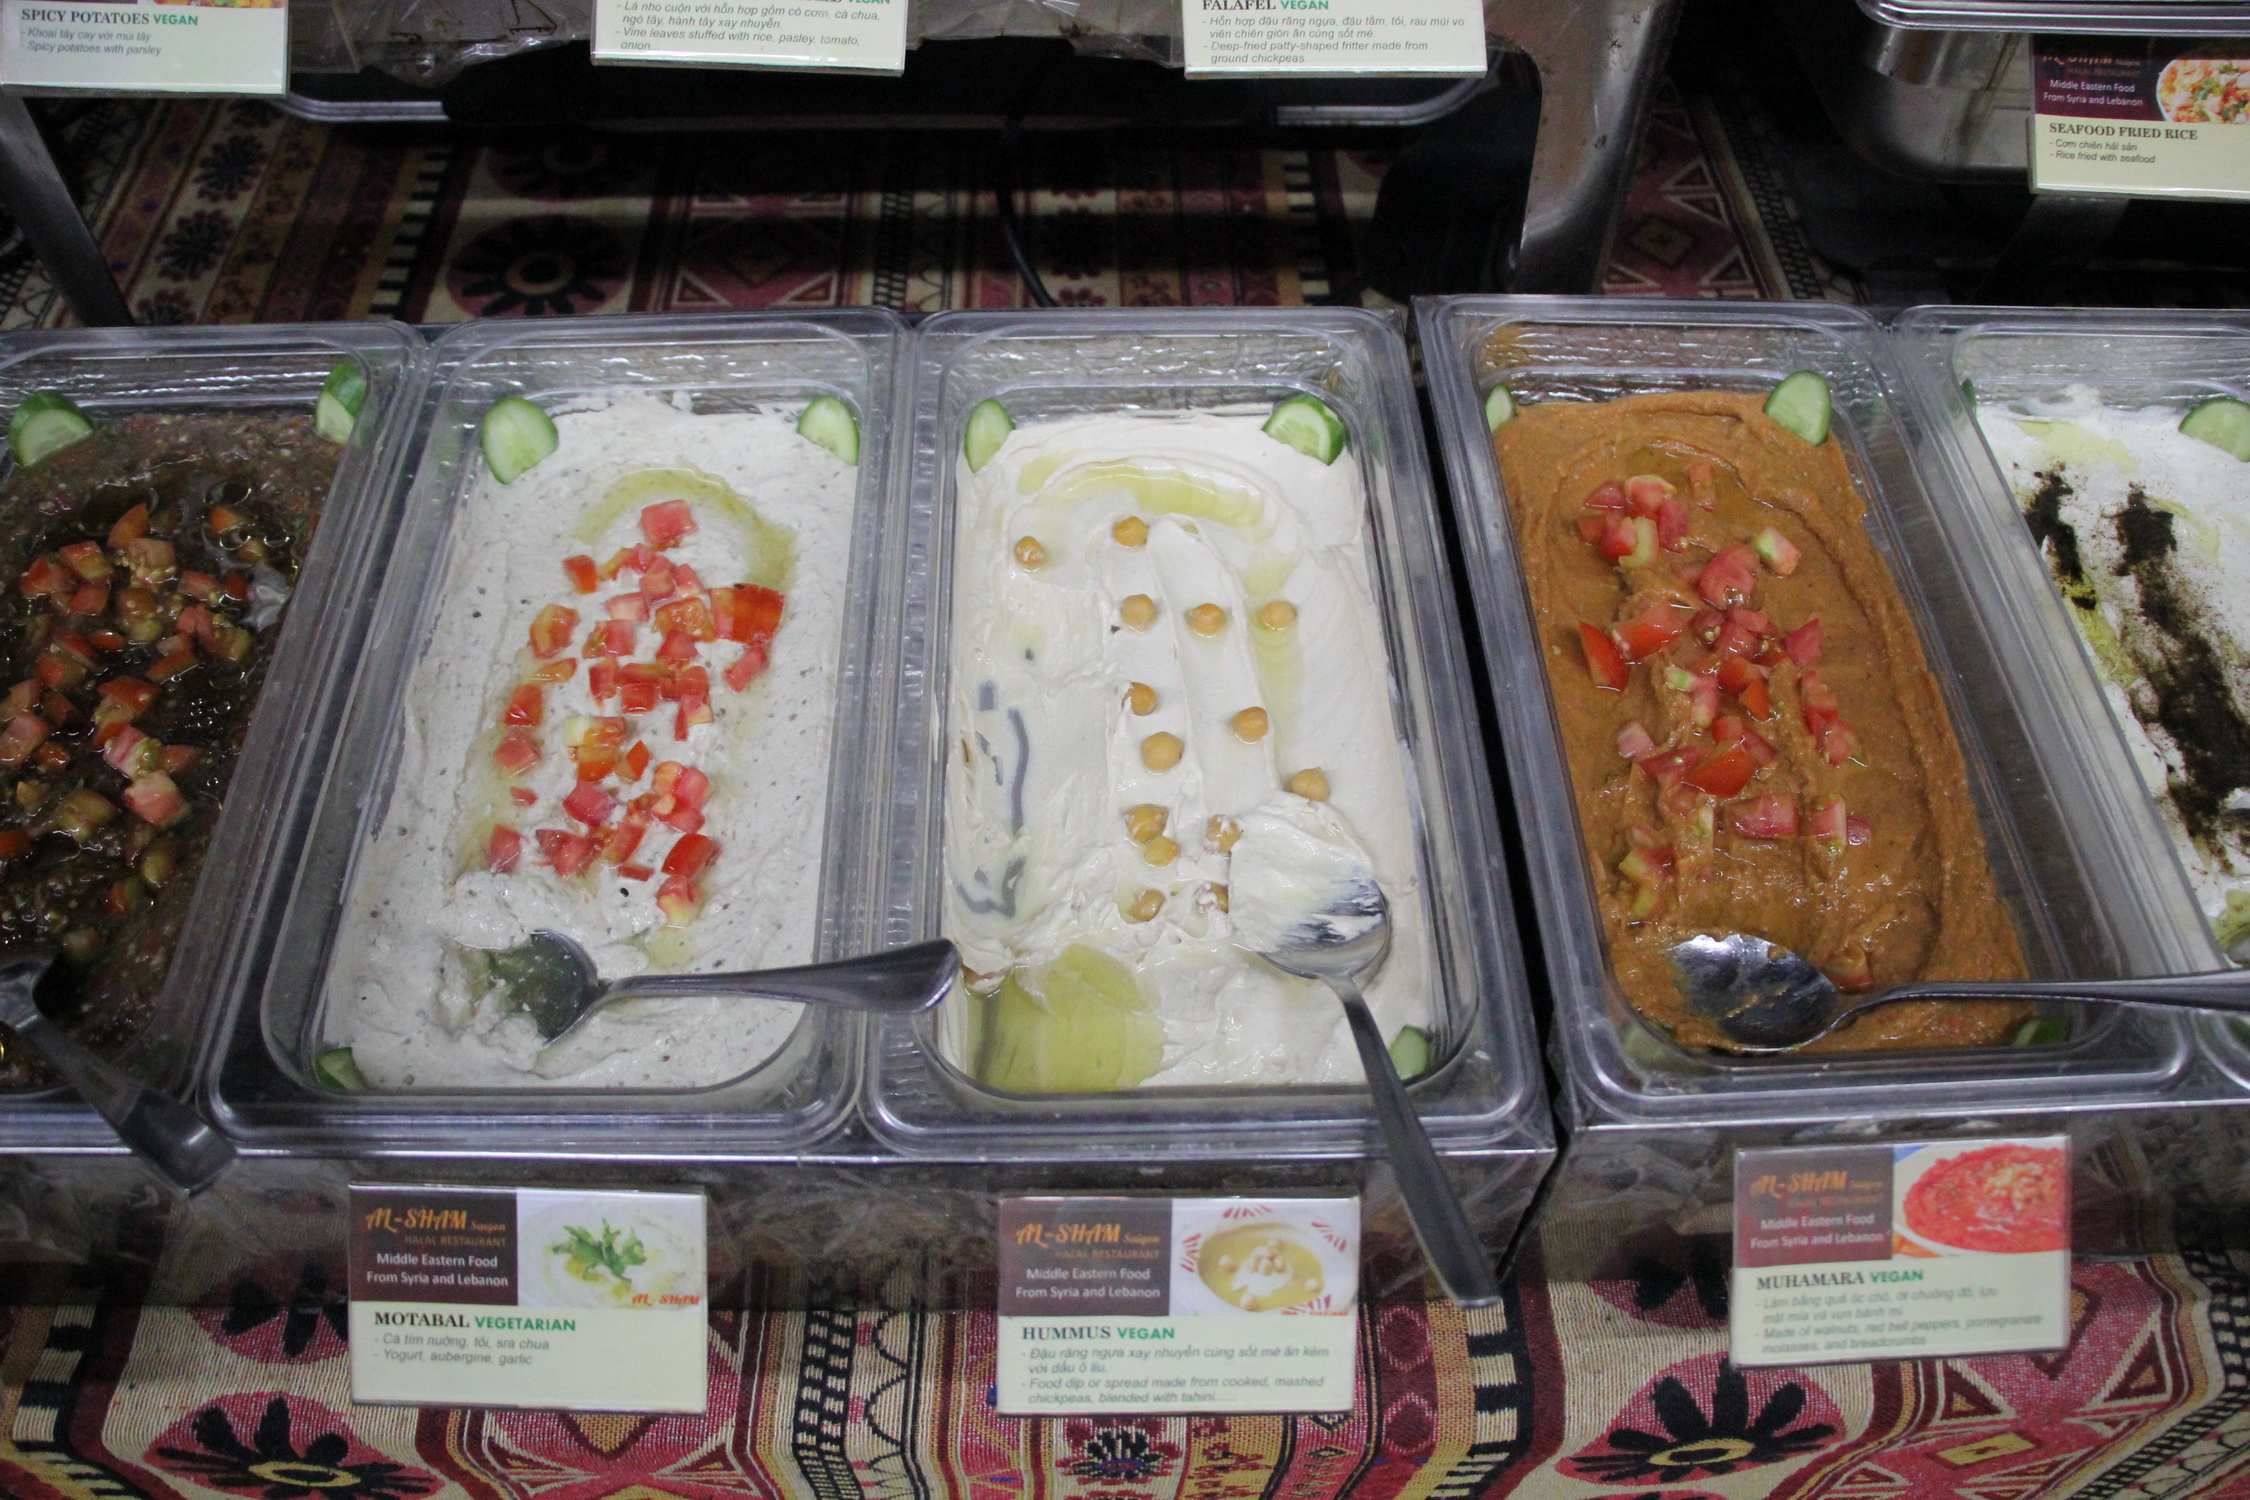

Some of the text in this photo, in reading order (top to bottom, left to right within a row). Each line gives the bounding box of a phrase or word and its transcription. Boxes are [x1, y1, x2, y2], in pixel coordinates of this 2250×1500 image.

[625, 2, 638, 11] Lá
[642, 3, 662, 11] nho
[665, 4, 691, 13] cuộn
[695, 5, 711, 13] với
[714, 3, 734, 13] hỗn
[737, 6, 757, 16] hợp
[761, 4, 785, 16] gồm
[788, 8, 802, 16] có
[835, 11, 848, 19] cà
[851, 11, 880, 21] chua,
[1203, 0, 1329, 10] FALAFEL VEGAN
[22, 9, 198, 25] SPICY POTATOES VEGAN
[669, 17, 695, 25] hành
[699, 17, 715, 28] tây
[718, 19, 737, 29] xay
[1210, 15, 1231, 26] Hỗn
[1235, 17, 1255, 27] hợp
[1259, 16, 1278, 26] đậu
[1282, 17, 1305, 27] răng
[1343, 16, 1362, 26] đậu
[1410, 18, 1426, 26] rau
[1430, 17, 1449, 26] mùi
[28, 28, 151, 42] Khoai tây cay với mùi tây
[623, 27, 646, 36] Vine
[650, 29, 685, 38] leaves
[688, 30, 725, 40] stuffed
[728, 32, 749, 40] with
[753, 32, 775, 42] rice,
[820, 36, 860, 46] tomato,
[1210, 29, 1231, 38] viên
[1235, 30, 1263, 38] chiên
[1267, 30, 1289, 39] giòn
[1293, 30, 1305, 38] ăn
[1309, 30, 1334, 39] cùng
[1338, 27, 1353, 38] sốt
[28, 42, 162, 56] Spicy potatoes with parsley
[1211, 41, 1428, 52] Deep-fried patty-shaped fritter made from
[1211, 54, 1305, 64] ground chickpeas
[2050, 80, 2135, 92] Middle Eastern Food
[2044, 93, 2143, 105] From Syria and Lebanon
[2050, 123, 2198, 139] SEAFOOD FRIED RICE
[2056, 139, 2077, 147] Cơm
[2056, 151, 2155, 163] Rice fried with seafood
[366, 1208, 467, 1233] AL-SHAM
[1761, 1213, 1874, 1230] Middle Eastern Food
[441, 1236, 505, 1246] RESTAURANT
[1016, 1223, 1120, 1248] AL-SHAM
[1751, 1232, 1884, 1248] From Syria and Lebanon
[377, 1253, 498, 1268] Middle Eastern Food
[367, 1271, 508, 1286] From Syria and Lebanon
[1027, 1268, 1150, 1279] Middle Eastern Food
[1757, 1270, 1923, 1290] MUHAMARA VEGAN
[1016, 1286, 1160, 1299] From Syria and Lebanon
[375, 1312, 576, 1331] MOTABAL VEGETARIAN
[1023, 1326, 1175, 1340] HUMMUS VEGAN
[519, 1339, 549, 1350] chua
[384, 1349, 533, 1366] Yogurt, aubergine, garlic
[1030, 1348, 1056, 1360] Đậu
[1128, 1350, 1150, 1361] xay
[1029, 1364, 1048, 1374] với
[1029, 1378, 1062, 1389] Food
[1065, 1379, 1084, 1390] dip
[1104, 1378, 1148, 1389] spread
[1152, 1378, 1186, 1388] made
[1190, 1377, 1218, 1387] from
[1222, 1377, 1269, 1388] cooked,
[1275, 1377, 1324, 1387] mashed
[1100, 1393, 1148, 1402] blended
[1153, 1392, 1177, 1402] with
